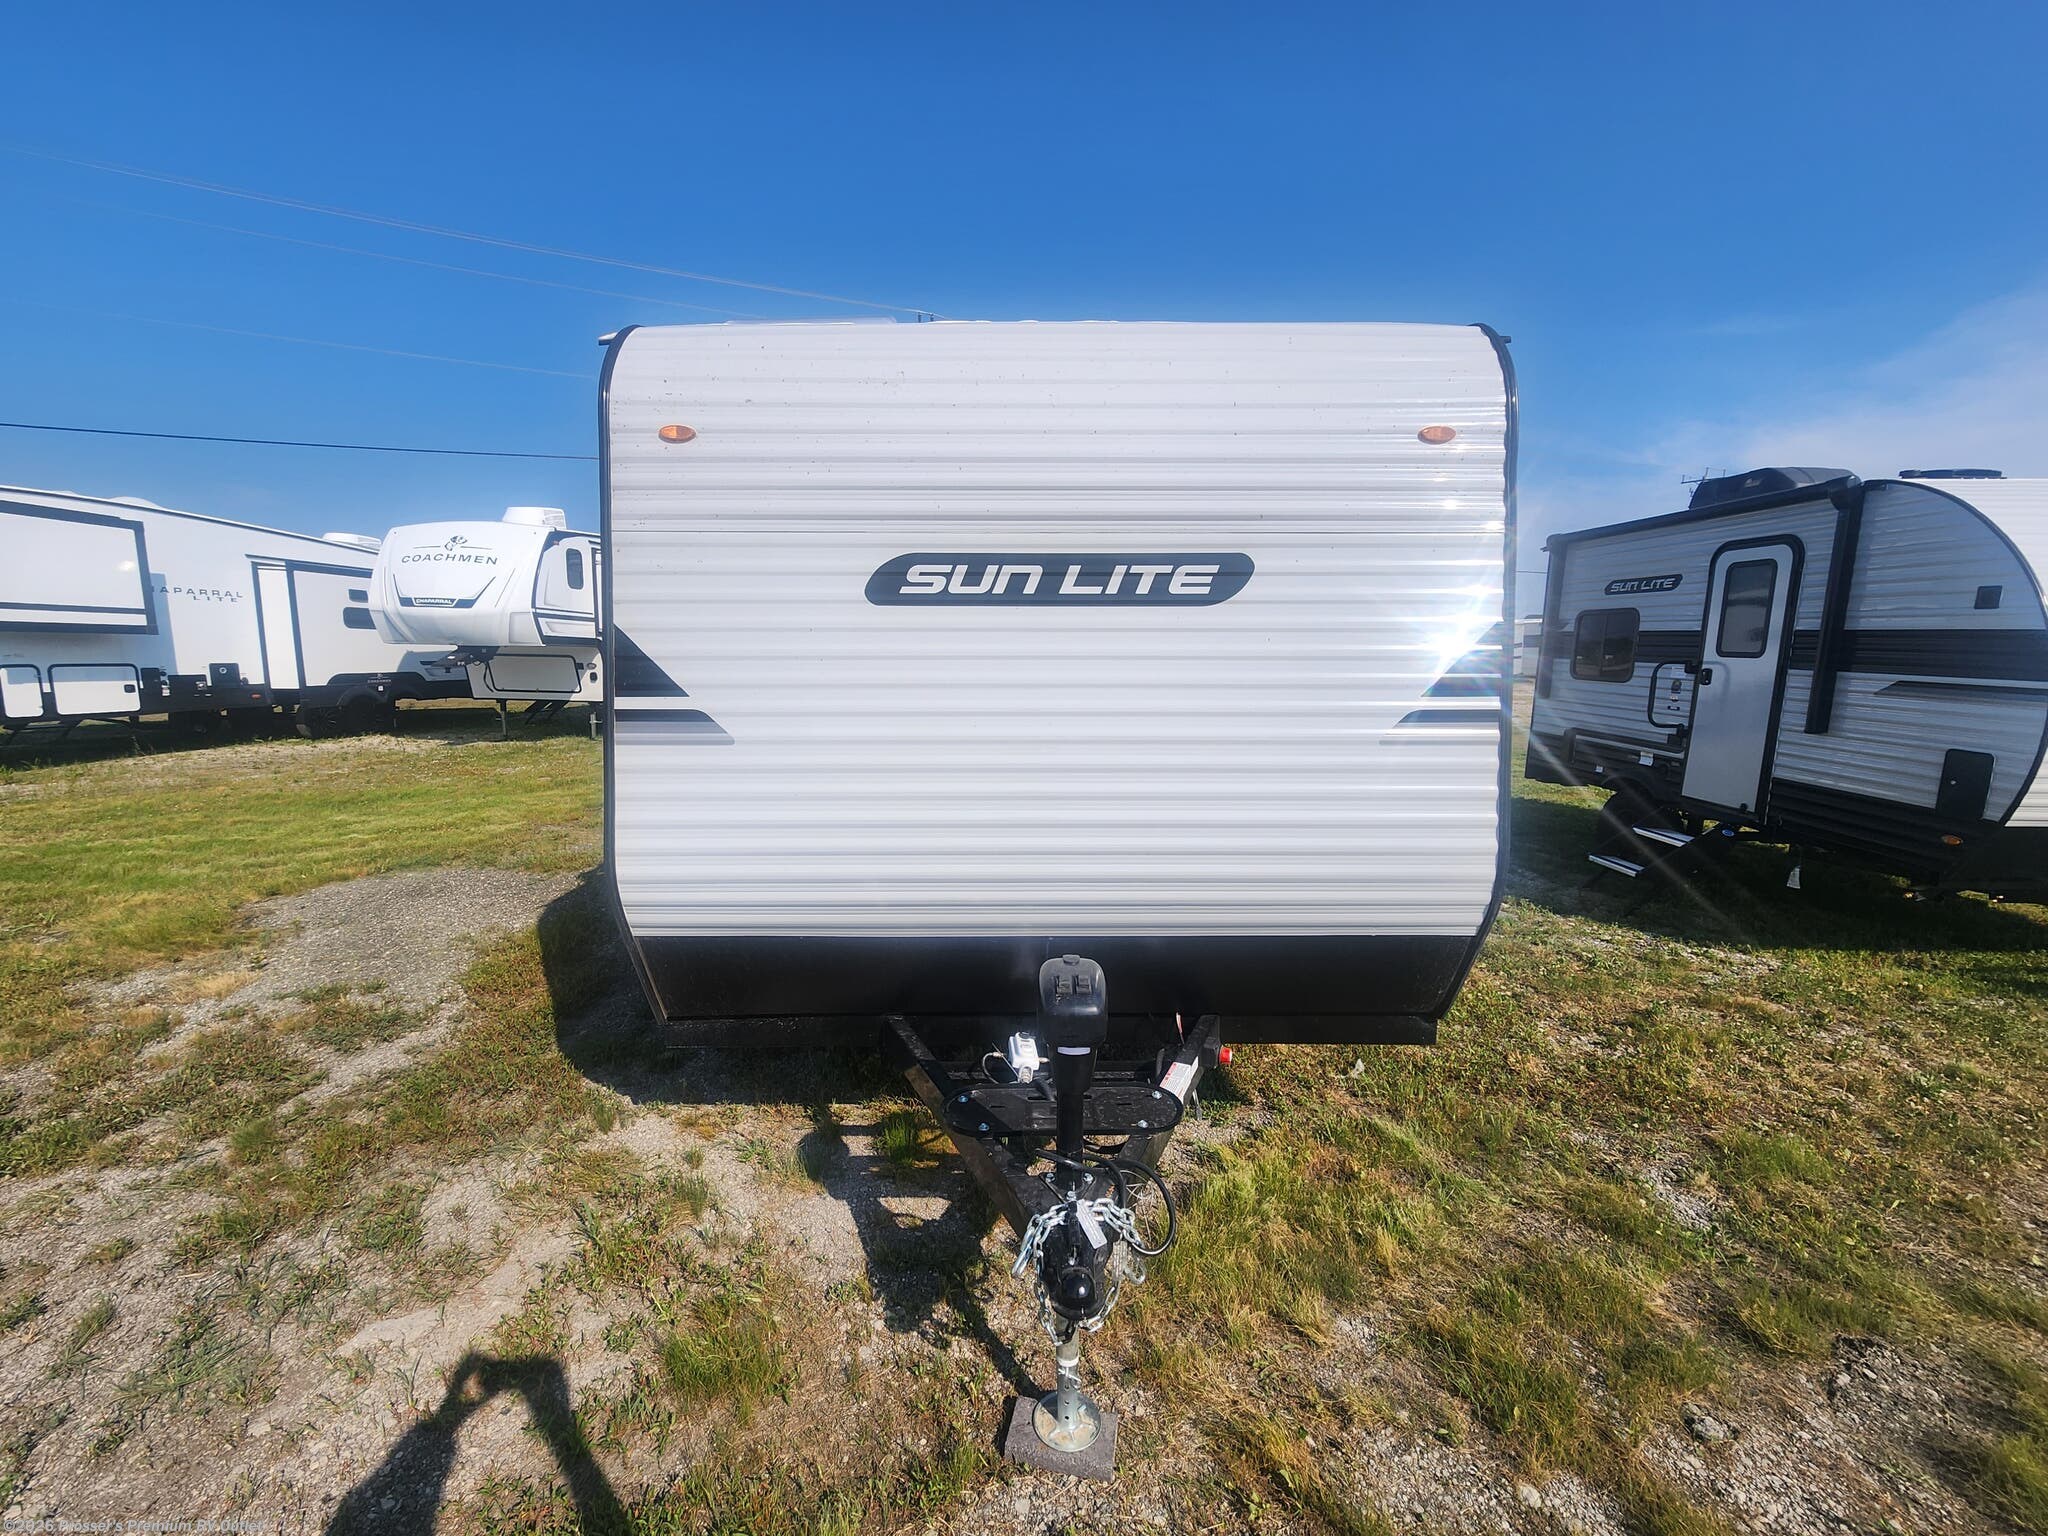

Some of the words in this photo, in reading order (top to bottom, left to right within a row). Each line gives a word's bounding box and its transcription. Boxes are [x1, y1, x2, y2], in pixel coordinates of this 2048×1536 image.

[401, 553, 498, 565] COACHMEN
[898, 564, 1044, 595] SUN
[1058, 564, 1222, 595] LITE
[1610, 581, 1639, 592] SUN
[1640, 578, 1676, 590] LITE
[152, 586, 243, 598] APARRAL
[193, 595, 238, 603] LITE
